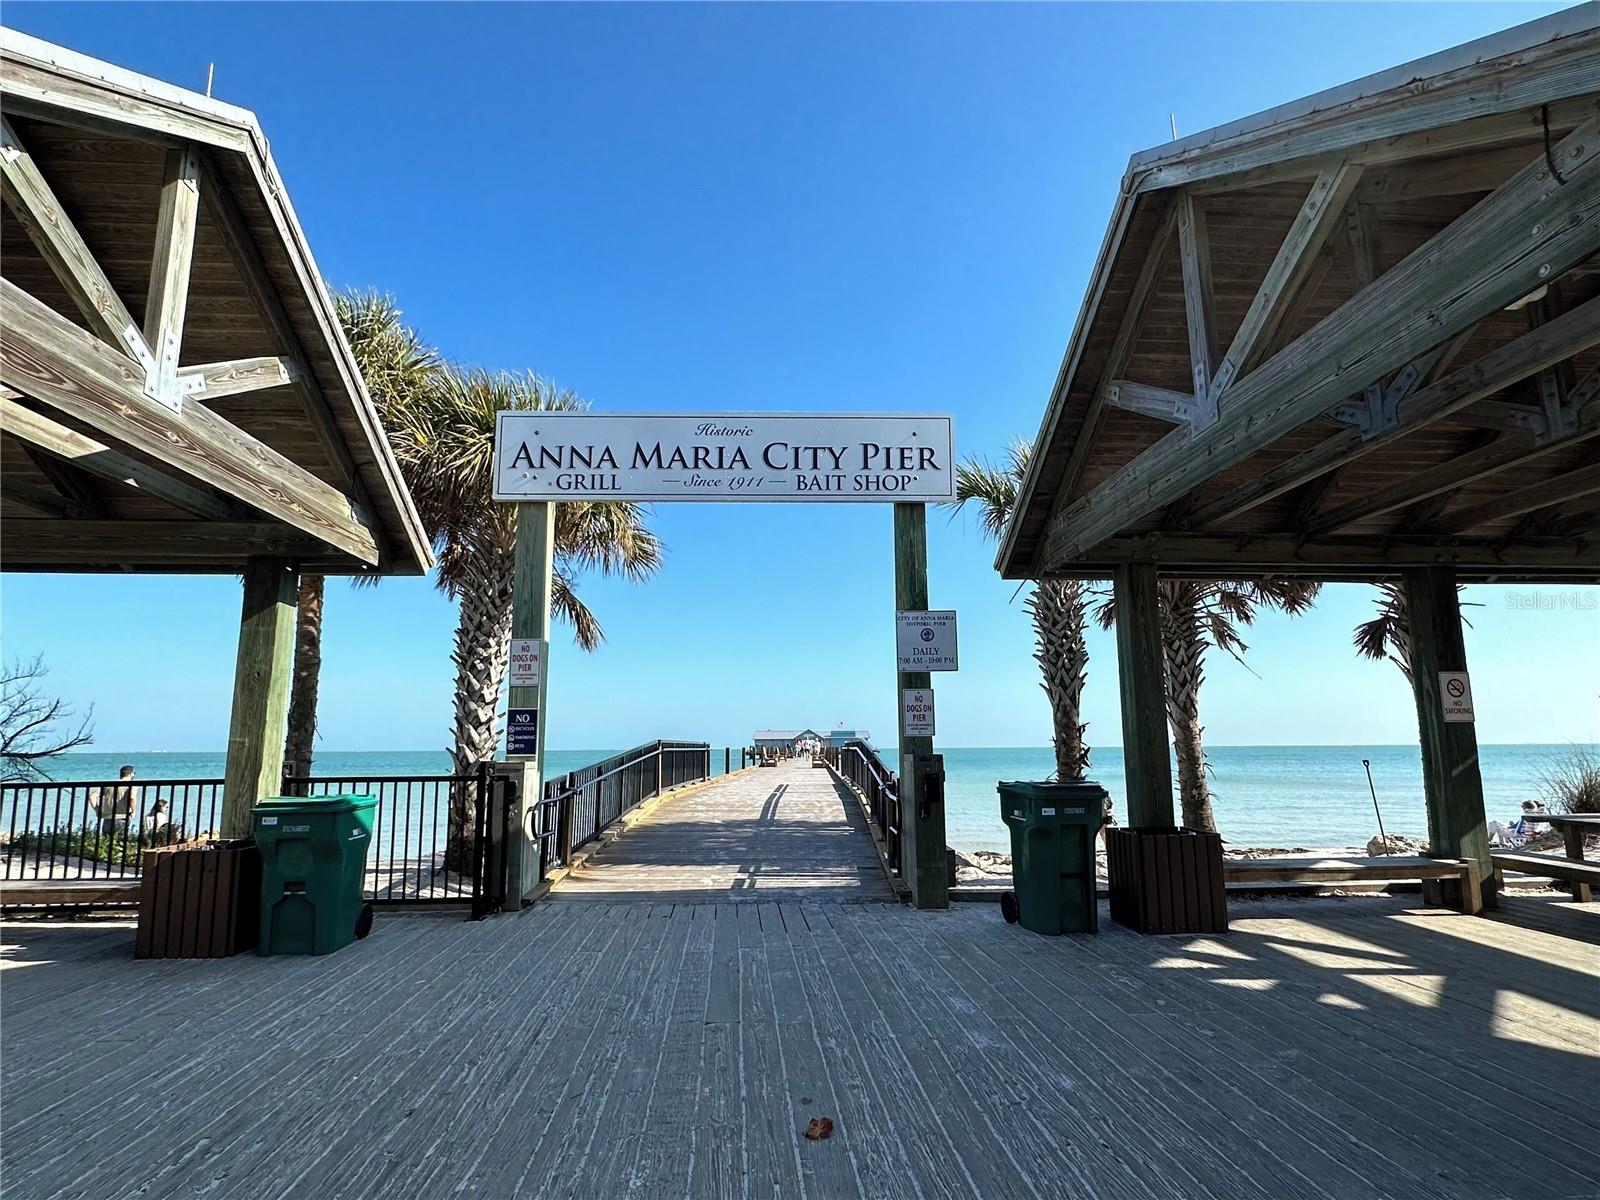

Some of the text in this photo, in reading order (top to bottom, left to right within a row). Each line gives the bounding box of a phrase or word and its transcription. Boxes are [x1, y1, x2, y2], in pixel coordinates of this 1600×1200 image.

[694, 423, 755, 437] Historic
[509, 441, 942, 471] ANNA MARIA CITY PIER
[556, 474, 622, 491] GRILL
[683, 473, 764, 489] Since 1911
[796, 474, 912, 491] BAIT SHOP
[912, 647, 940, 655] DAILY
[512, 654, 538, 662] DOGS ON
[518, 663, 532, 671] PIER
[906, 704, 931, 712] DOGS ON
[515, 713, 530, 722] NO
[912, 713, 926, 721] PIER
